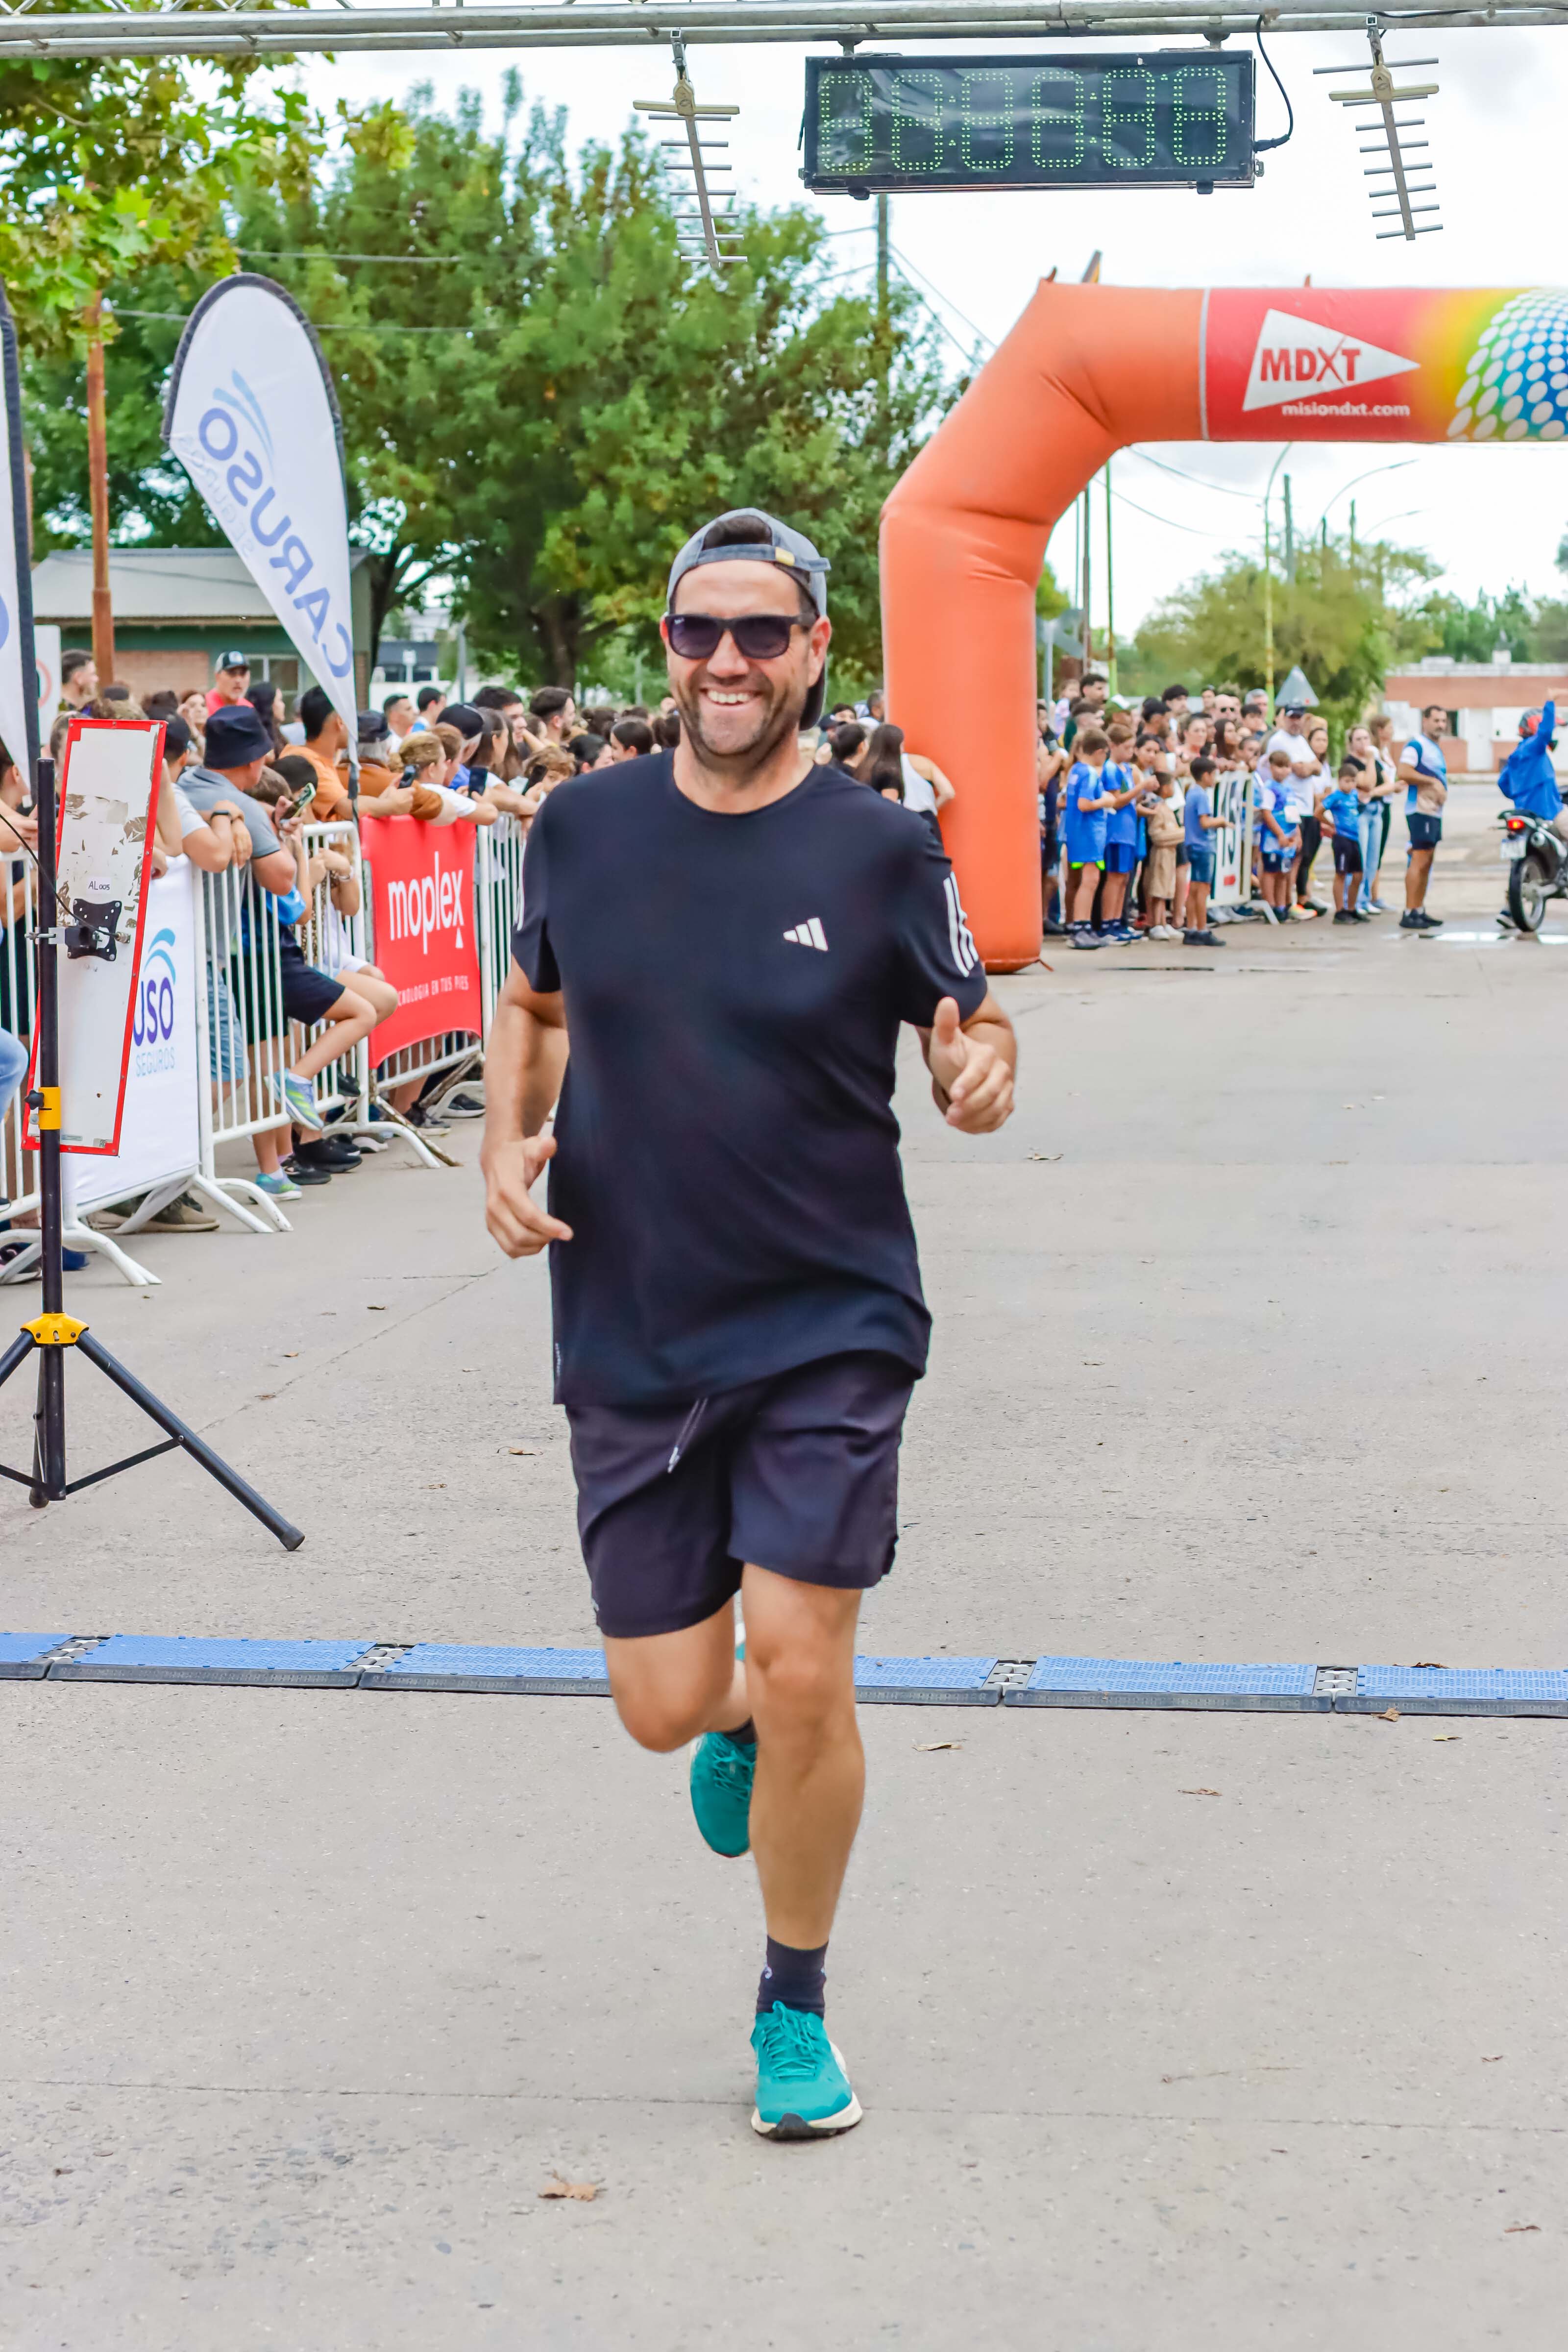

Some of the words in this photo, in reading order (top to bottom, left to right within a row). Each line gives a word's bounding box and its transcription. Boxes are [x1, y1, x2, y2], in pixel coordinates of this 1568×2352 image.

[1260, 335, 1362, 385] MDXT
[1281, 401, 1410, 416] misiondxt.com
[388, 851, 464, 954] moplex
[431, 980, 439, 995] EN
[441, 977, 452, 992] TUS
[454, 975, 469, 991] PIES
[136, 1046, 175, 1077] SEGUROS
